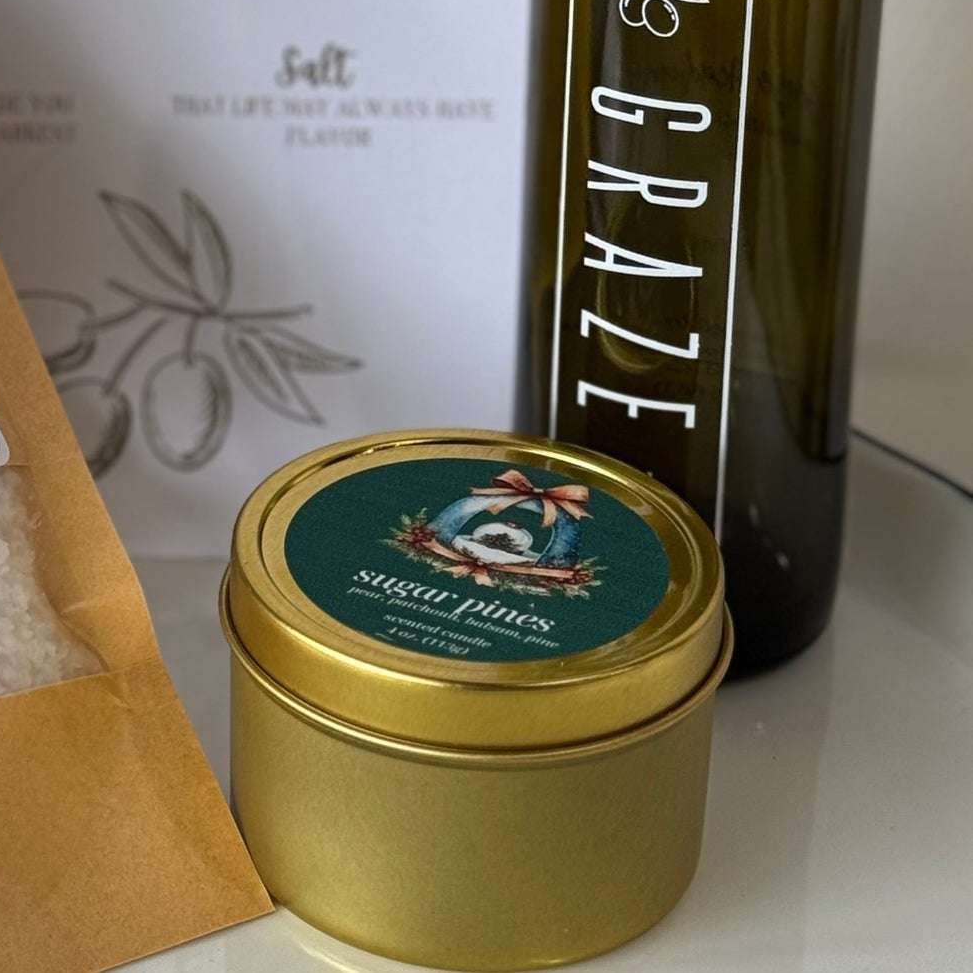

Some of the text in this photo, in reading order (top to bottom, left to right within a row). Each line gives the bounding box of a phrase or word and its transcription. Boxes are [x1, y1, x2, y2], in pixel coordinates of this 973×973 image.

[275, 41, 358, 89] Salt
[577, 85, 712, 429] GRAZE
[352, 569, 556, 632] sugar pines
[383, 614, 492, 648] scented candle
